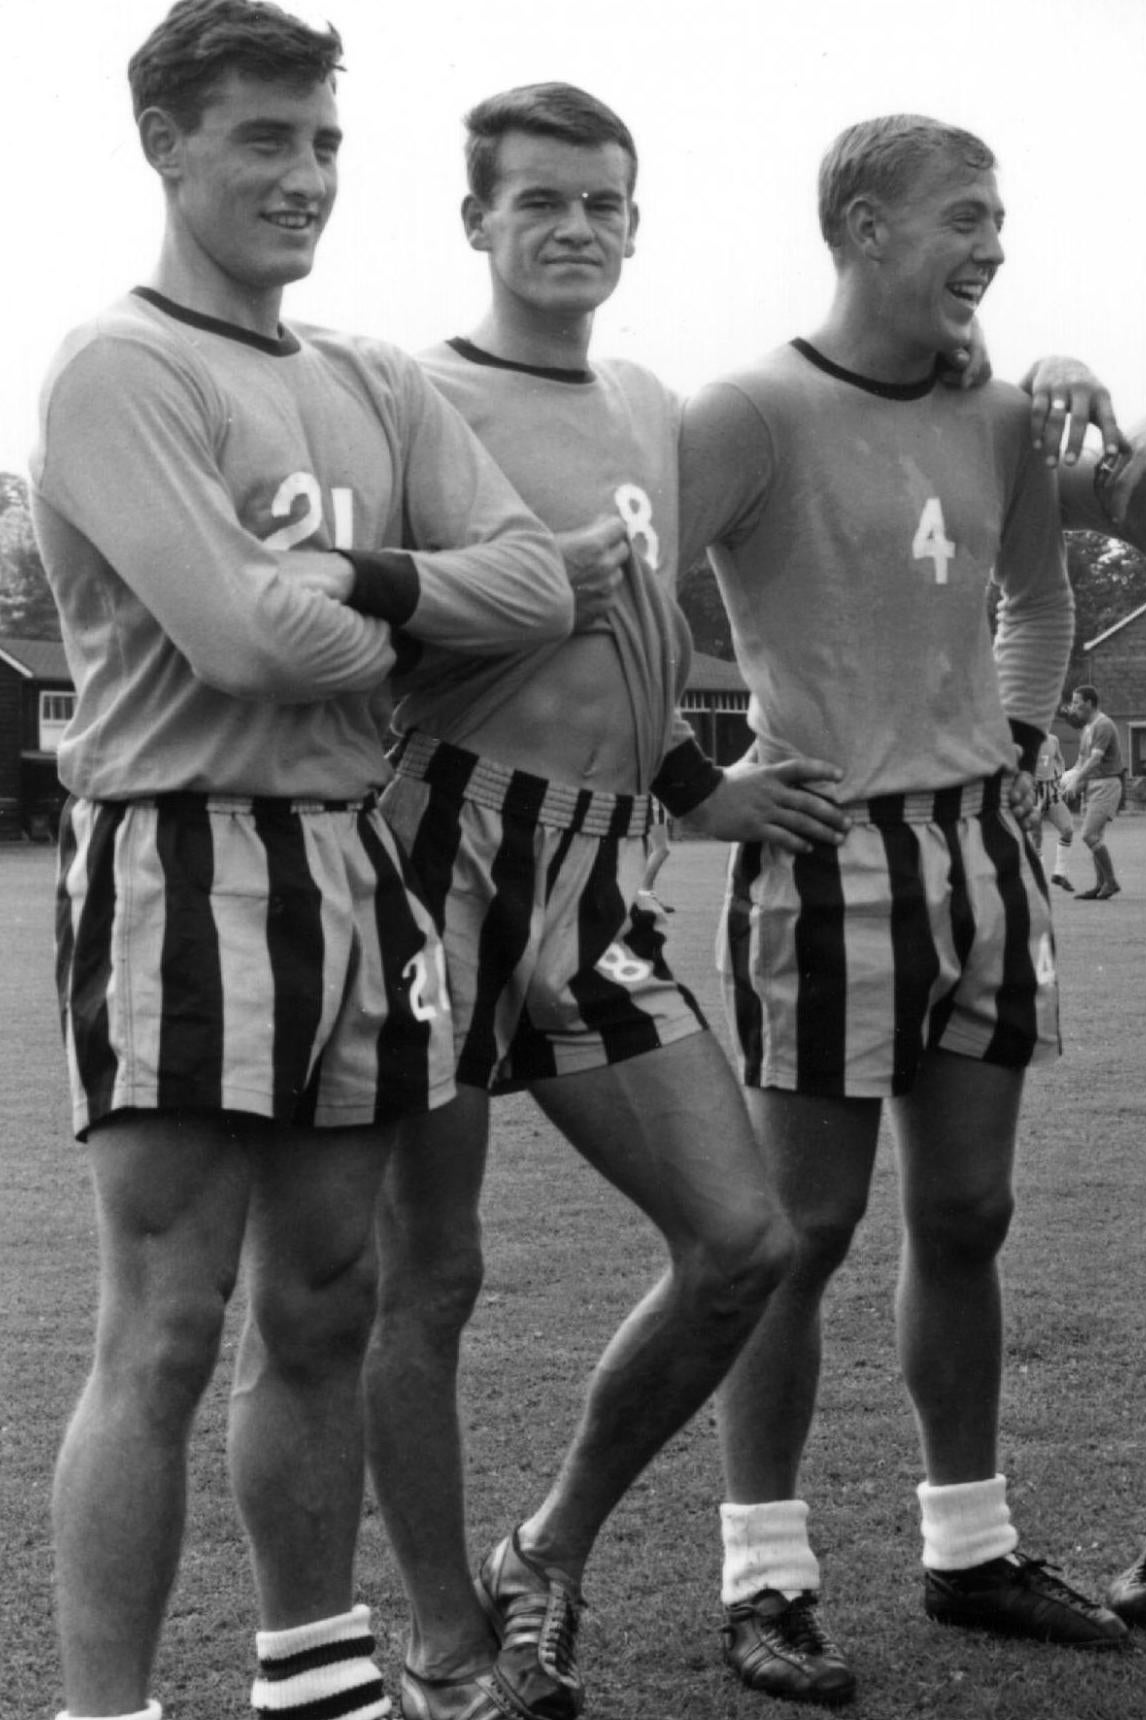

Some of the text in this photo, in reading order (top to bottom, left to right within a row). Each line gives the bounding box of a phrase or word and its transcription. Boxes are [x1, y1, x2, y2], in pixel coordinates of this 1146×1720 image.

[260, 471, 353, 551] 21
[614, 483, 659, 570] 8
[912, 497, 956, 584] 4
[402, 942, 451, 1022] 21
[597, 941, 650, 981] 8
